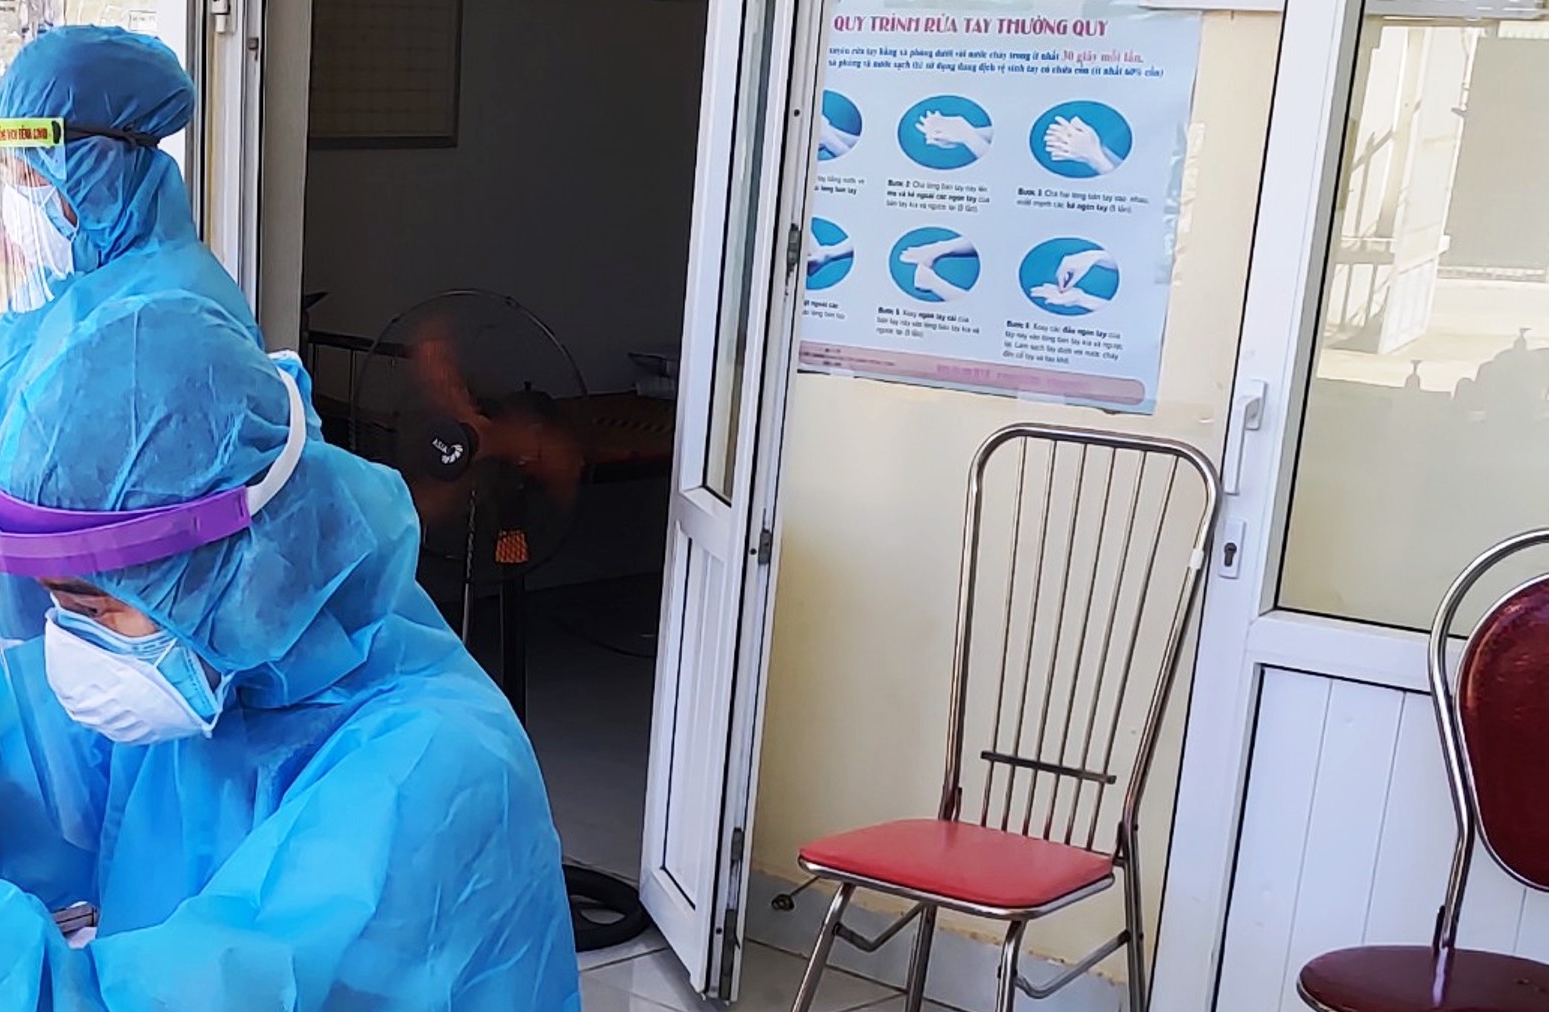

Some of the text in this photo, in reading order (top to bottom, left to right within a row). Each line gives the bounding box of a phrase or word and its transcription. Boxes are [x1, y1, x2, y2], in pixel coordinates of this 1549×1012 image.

[834, 13, 1109, 36] QUY TRÌNH RỬA TAY THƯỜNG QUY
[1062, 50, 1075, 61] 30
